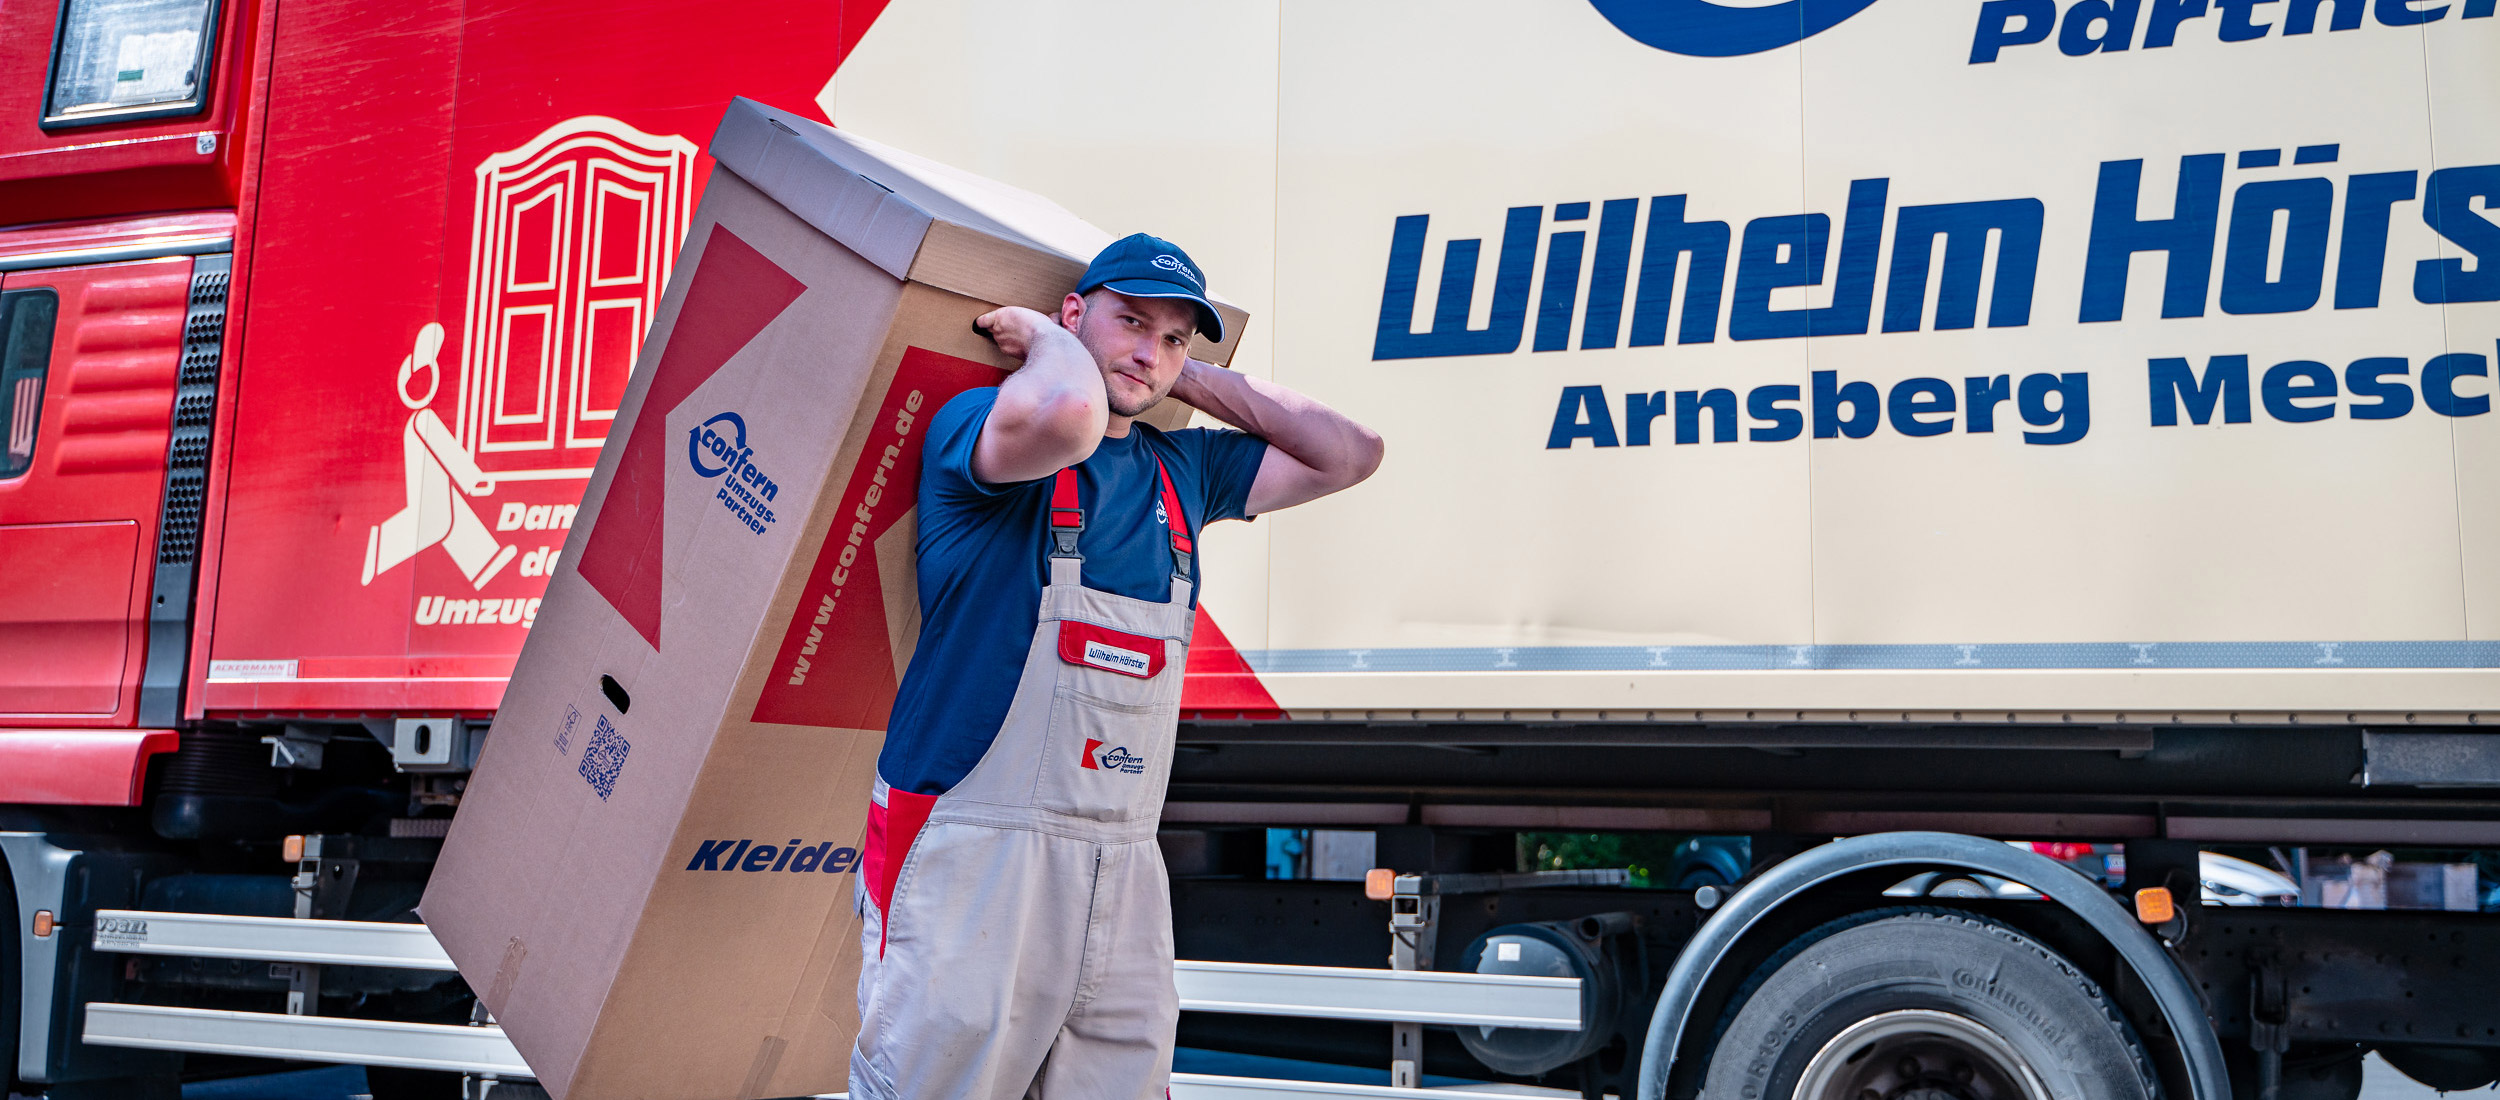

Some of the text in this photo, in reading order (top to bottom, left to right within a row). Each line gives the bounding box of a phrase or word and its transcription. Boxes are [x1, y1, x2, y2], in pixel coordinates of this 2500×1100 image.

[1372, 178, 2044, 361] Wilhelm
[1546, 338, 2500, 449] Arnsberg Mesc
[701, 429, 778, 503] confern
[788, 389, 924, 686] www.confern.de
[214, 663, 285, 672] ACKERMANN
[1088, 647, 1146, 669] Wilhelm Hörster
[1107, 753, 1144, 764] confern
[97, 918, 147, 934] VOGEL
[1951, 967, 2069, 1047] Continental
